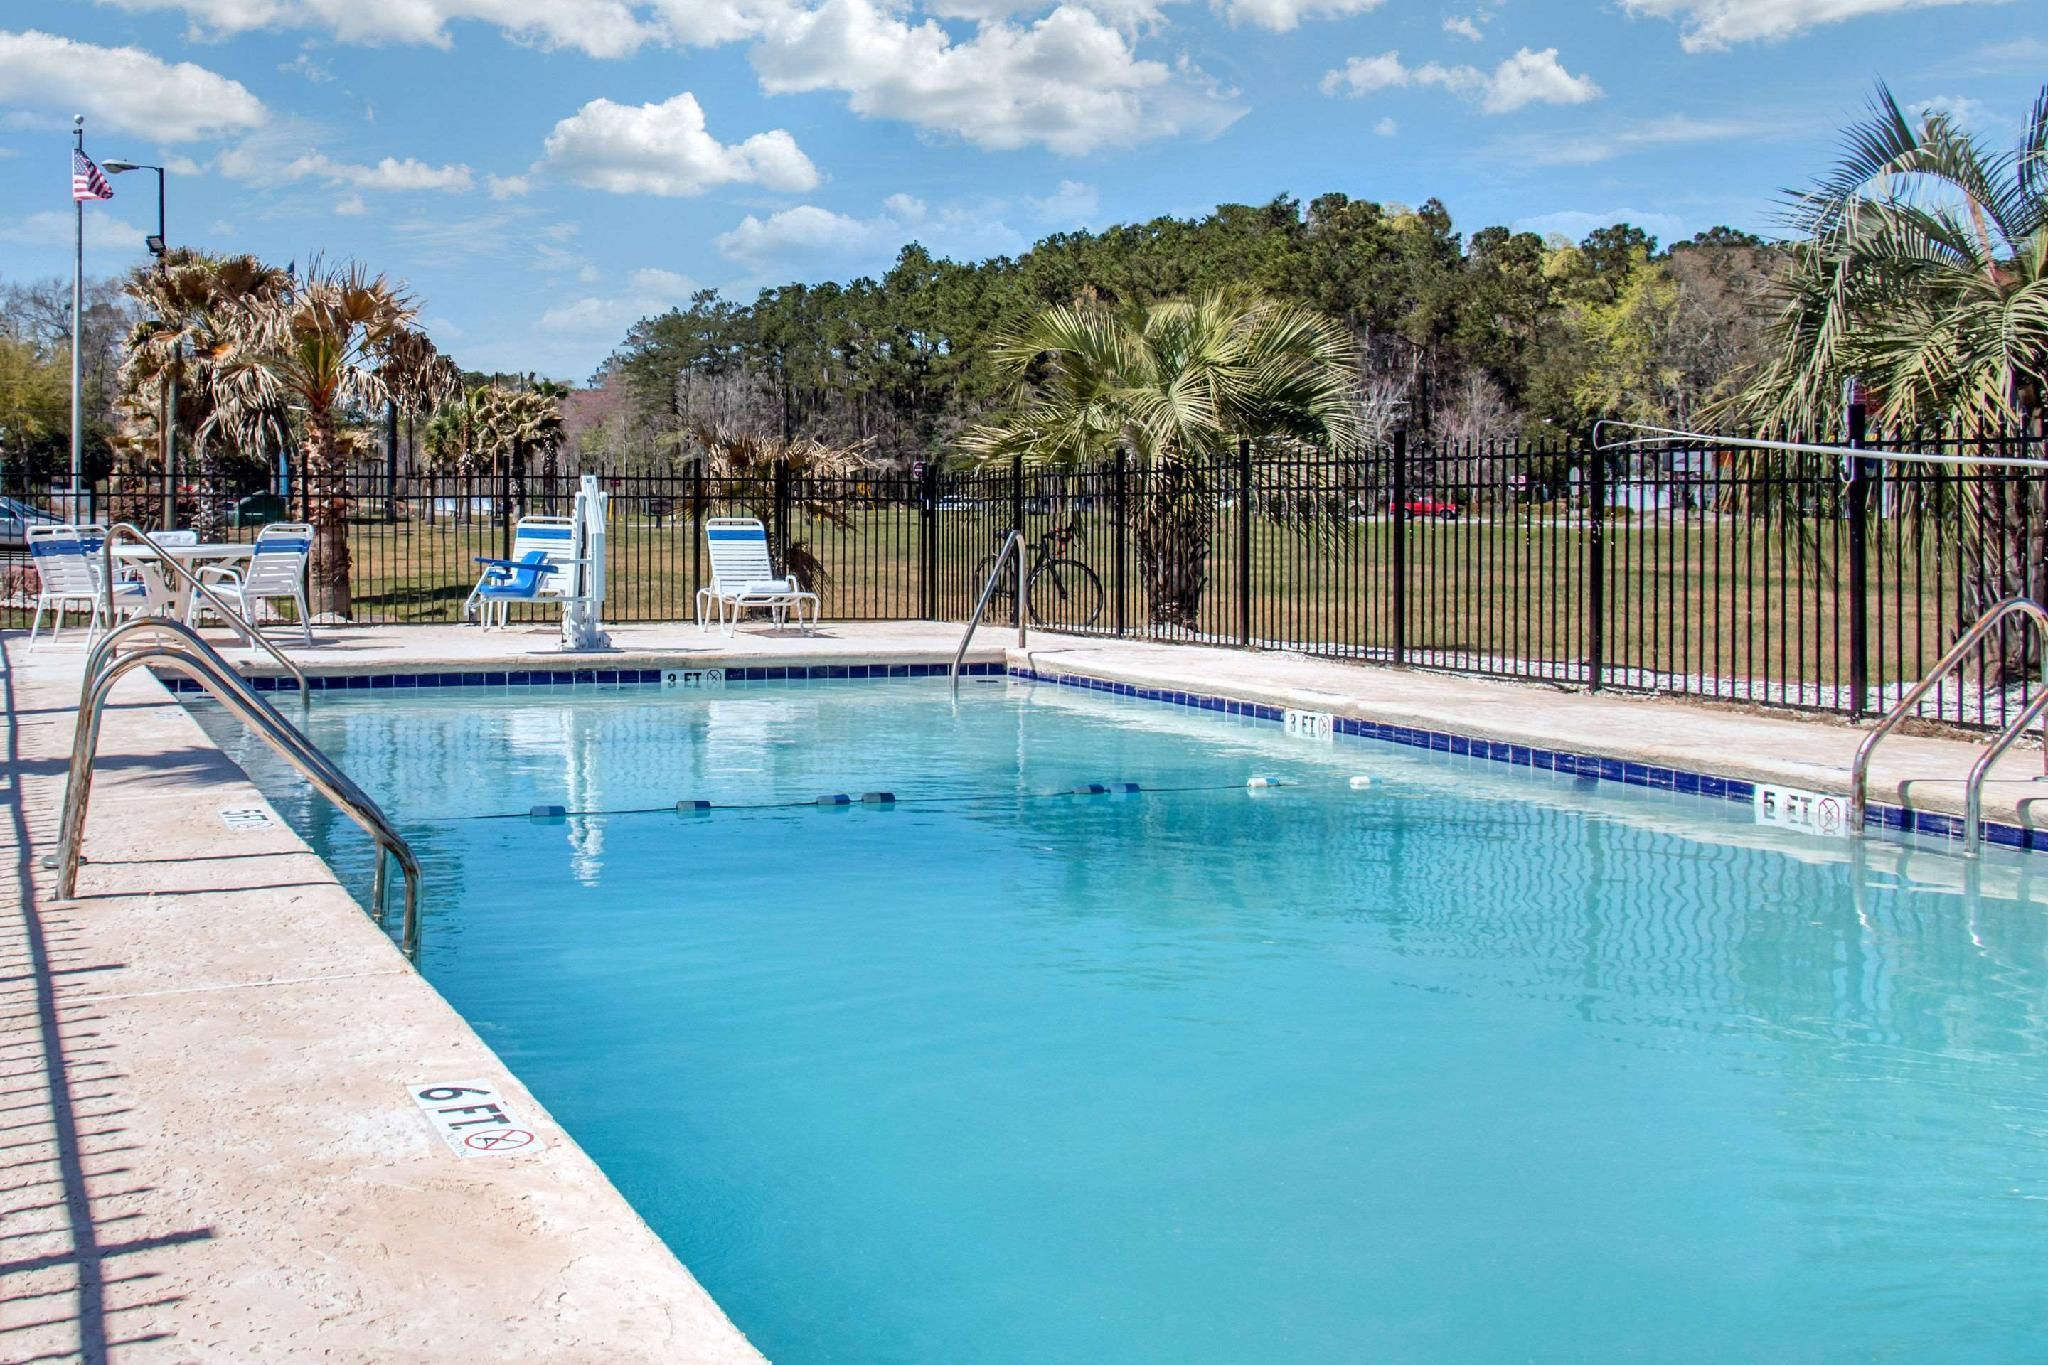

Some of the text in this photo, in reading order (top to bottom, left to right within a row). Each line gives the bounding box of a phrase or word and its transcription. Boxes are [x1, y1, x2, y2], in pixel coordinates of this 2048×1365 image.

[668, 673, 702, 683] 3 FT
[1302, 715, 1317, 729] FT
[1764, 791, 1813, 814] 5 FT
[418, 1087, 492, 1101] 6
